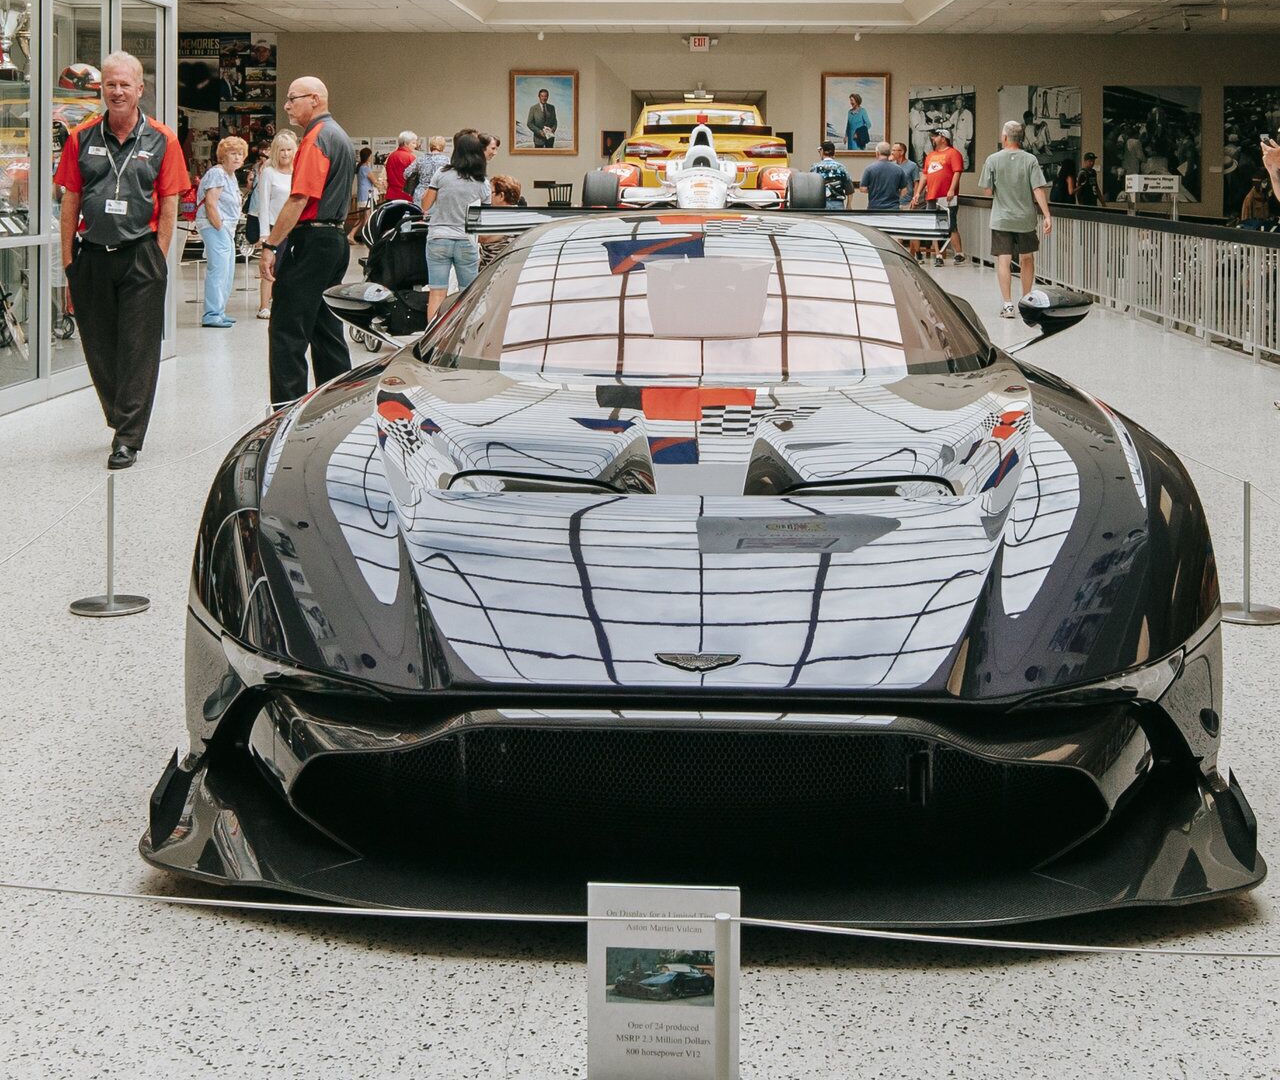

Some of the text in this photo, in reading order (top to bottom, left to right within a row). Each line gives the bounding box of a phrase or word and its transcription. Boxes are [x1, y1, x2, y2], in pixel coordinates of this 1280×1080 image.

[693, 37, 706, 48] EXIT
[606, 909, 617, 918] On
[626, 924, 702, 933] Aston Martin Vulcan
[627, 1021, 700, 1033] One of 24 produced
[616, 1034, 711, 1046] MSRP 2.3 Million Dollars
[625, 1047, 701, 1060] 800 horsepower V12
